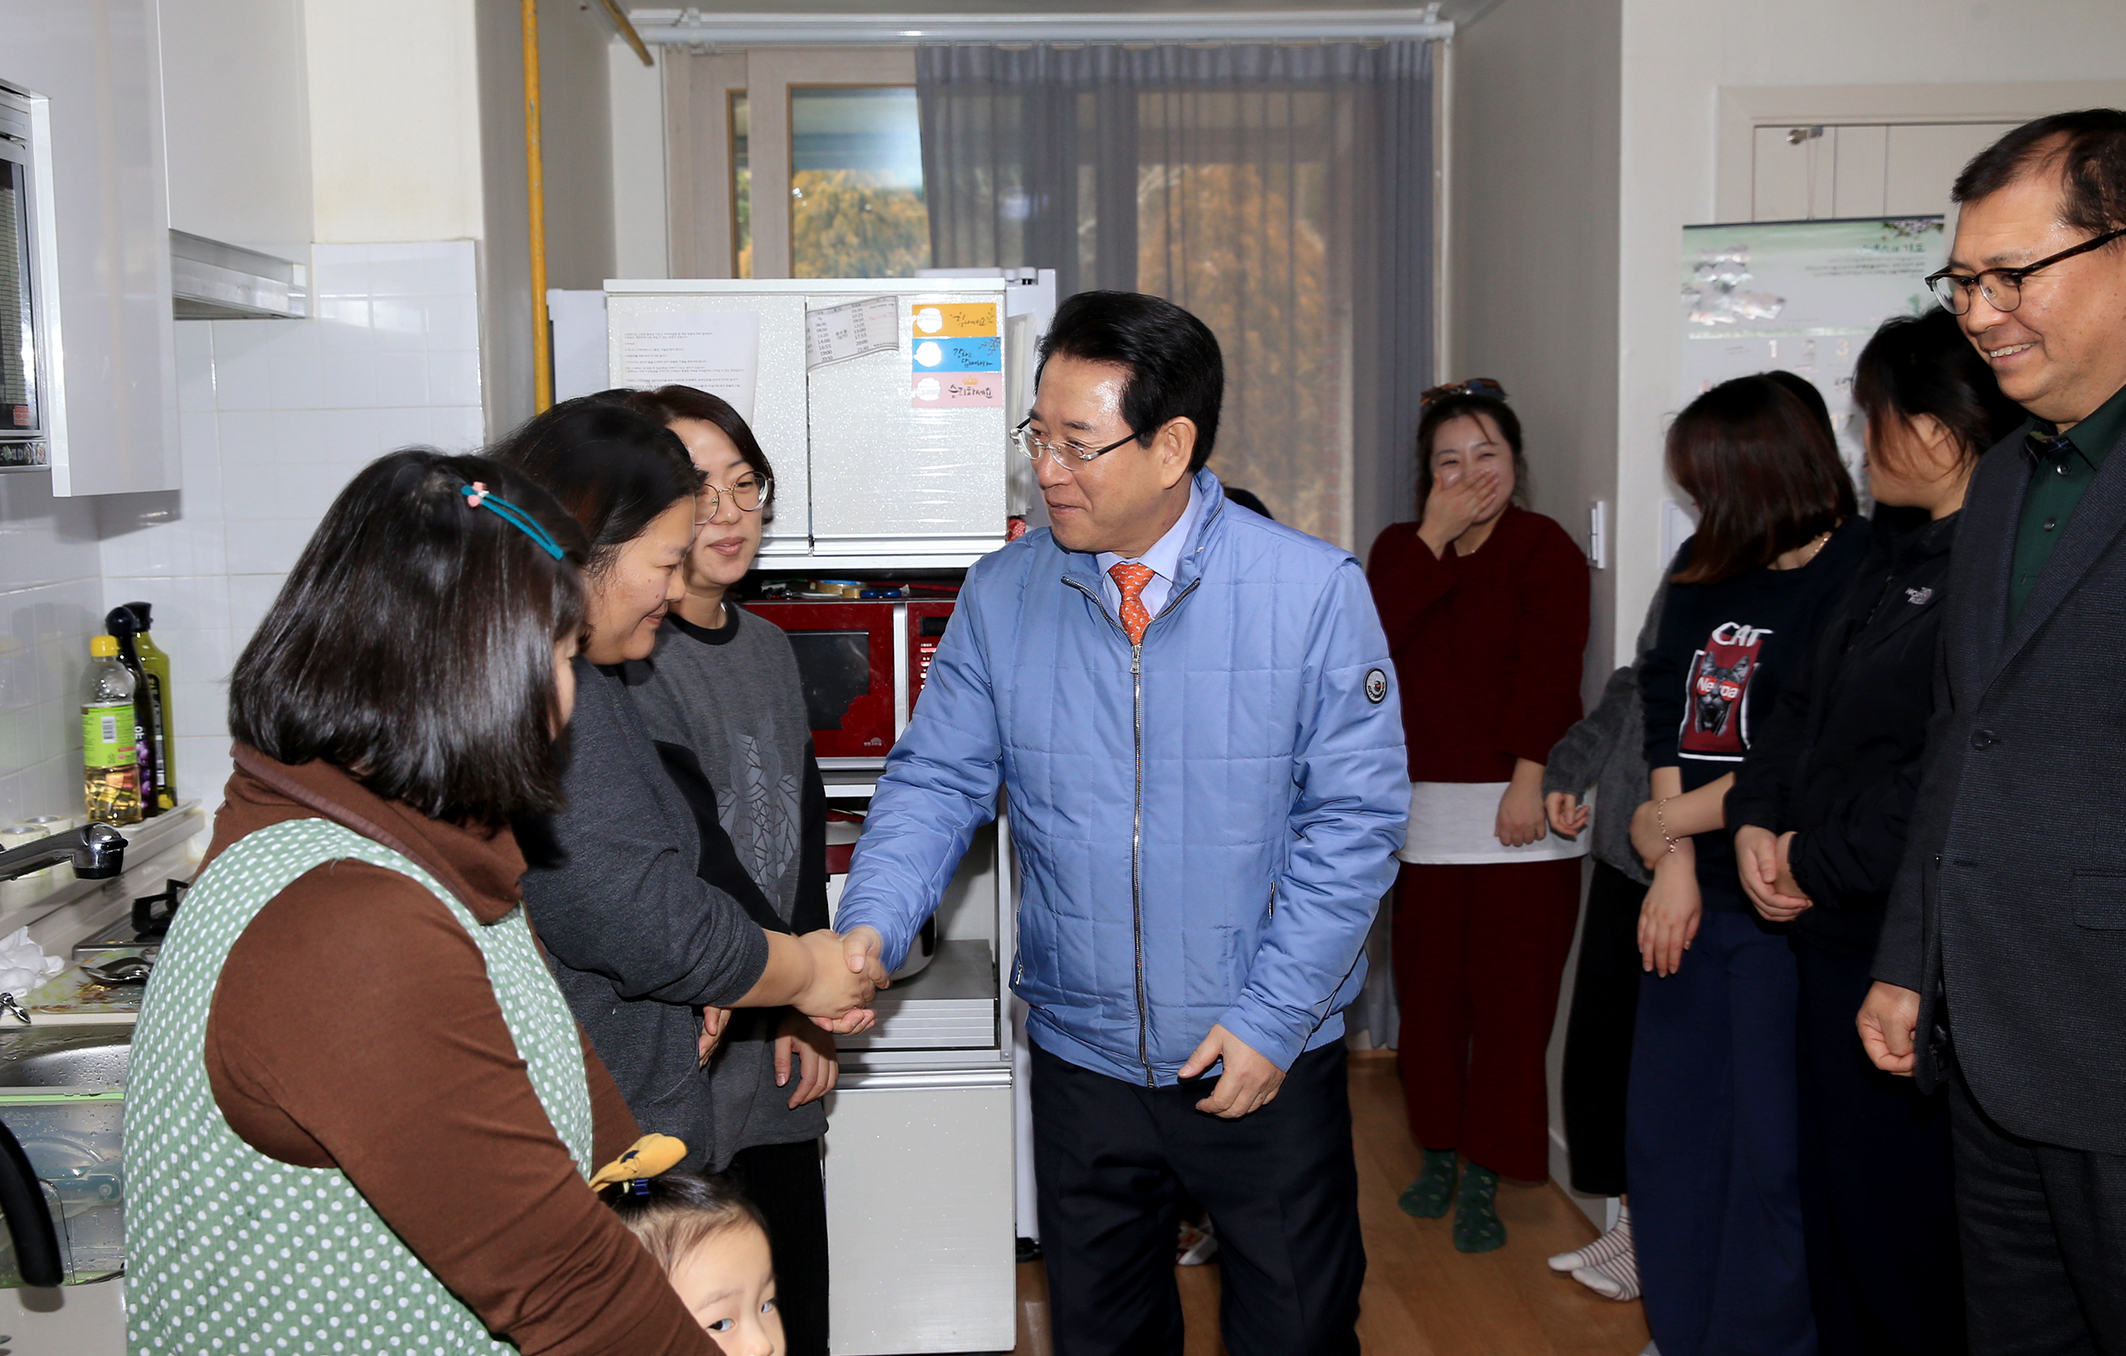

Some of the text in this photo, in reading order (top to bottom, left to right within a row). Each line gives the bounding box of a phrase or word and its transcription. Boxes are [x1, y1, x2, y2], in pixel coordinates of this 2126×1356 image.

[1768, 339, 1778, 358] 1
[1835, 338, 1850, 356] 3
[948, 384, 993, 399] 승리하세요
[1711, 621, 1774, 647] CAT
